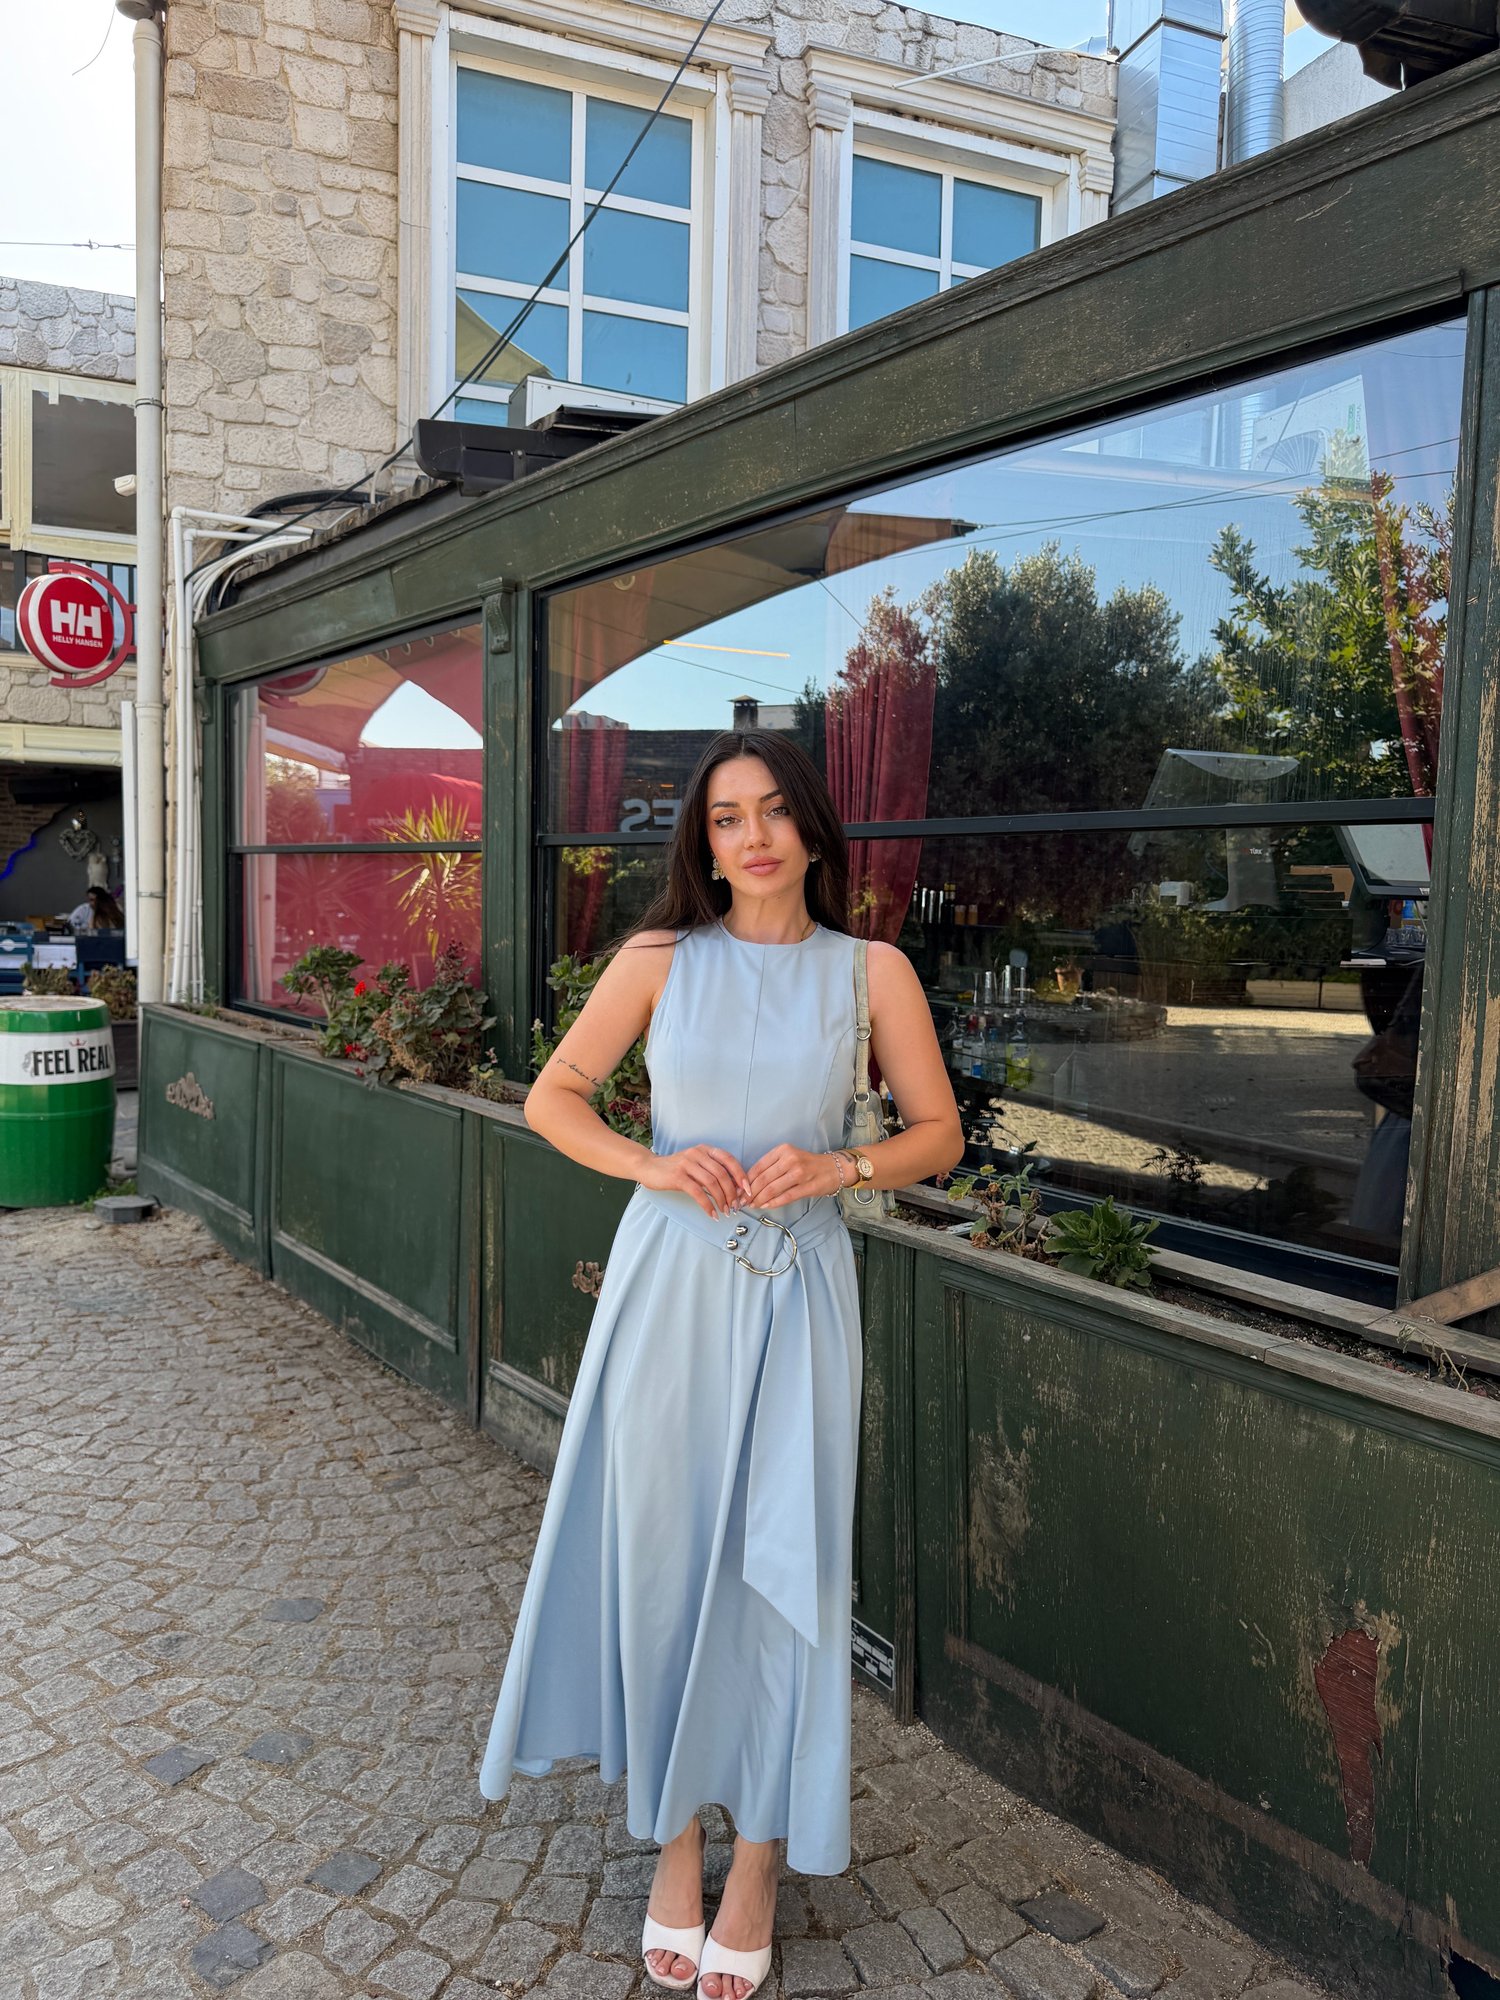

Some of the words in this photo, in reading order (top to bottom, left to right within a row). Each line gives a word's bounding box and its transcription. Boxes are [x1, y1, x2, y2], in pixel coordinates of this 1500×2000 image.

[50, 599, 102, 639] HH
[52, 634, 74, 644] HELLY
[75, 637, 103, 648] HANSEN
[32, 1049, 75, 1076] FEEL
[77, 1044, 110, 1073] REAL
